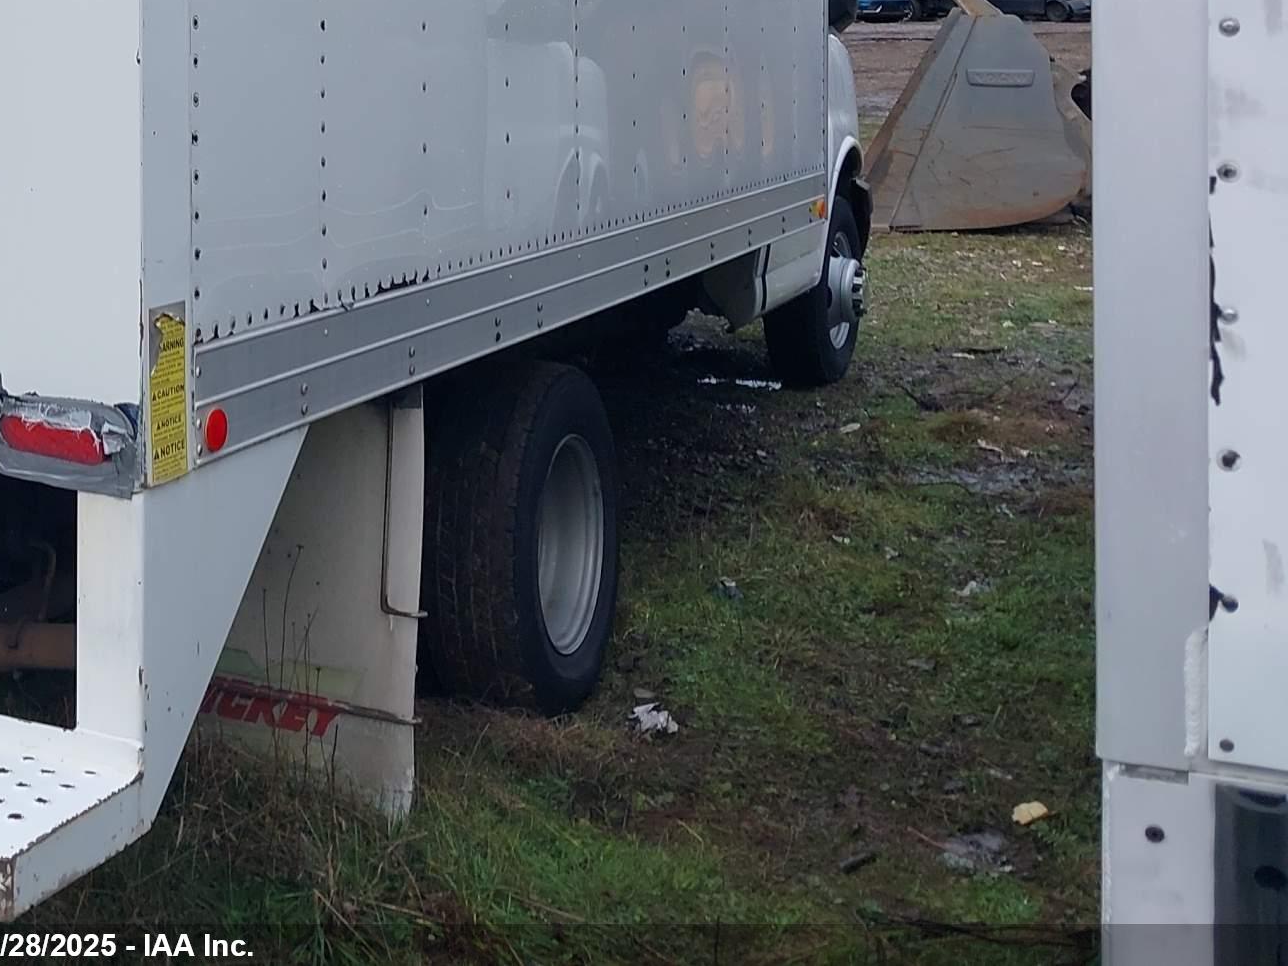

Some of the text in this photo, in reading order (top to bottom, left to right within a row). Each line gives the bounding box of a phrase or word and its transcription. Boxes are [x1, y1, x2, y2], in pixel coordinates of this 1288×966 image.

[157, 384, 184, 400] CAUTION
[161, 413, 182, 428] NOTICE
[160, 438, 185, 459] NOTICE
[199, 676, 350, 737] ICKEY
